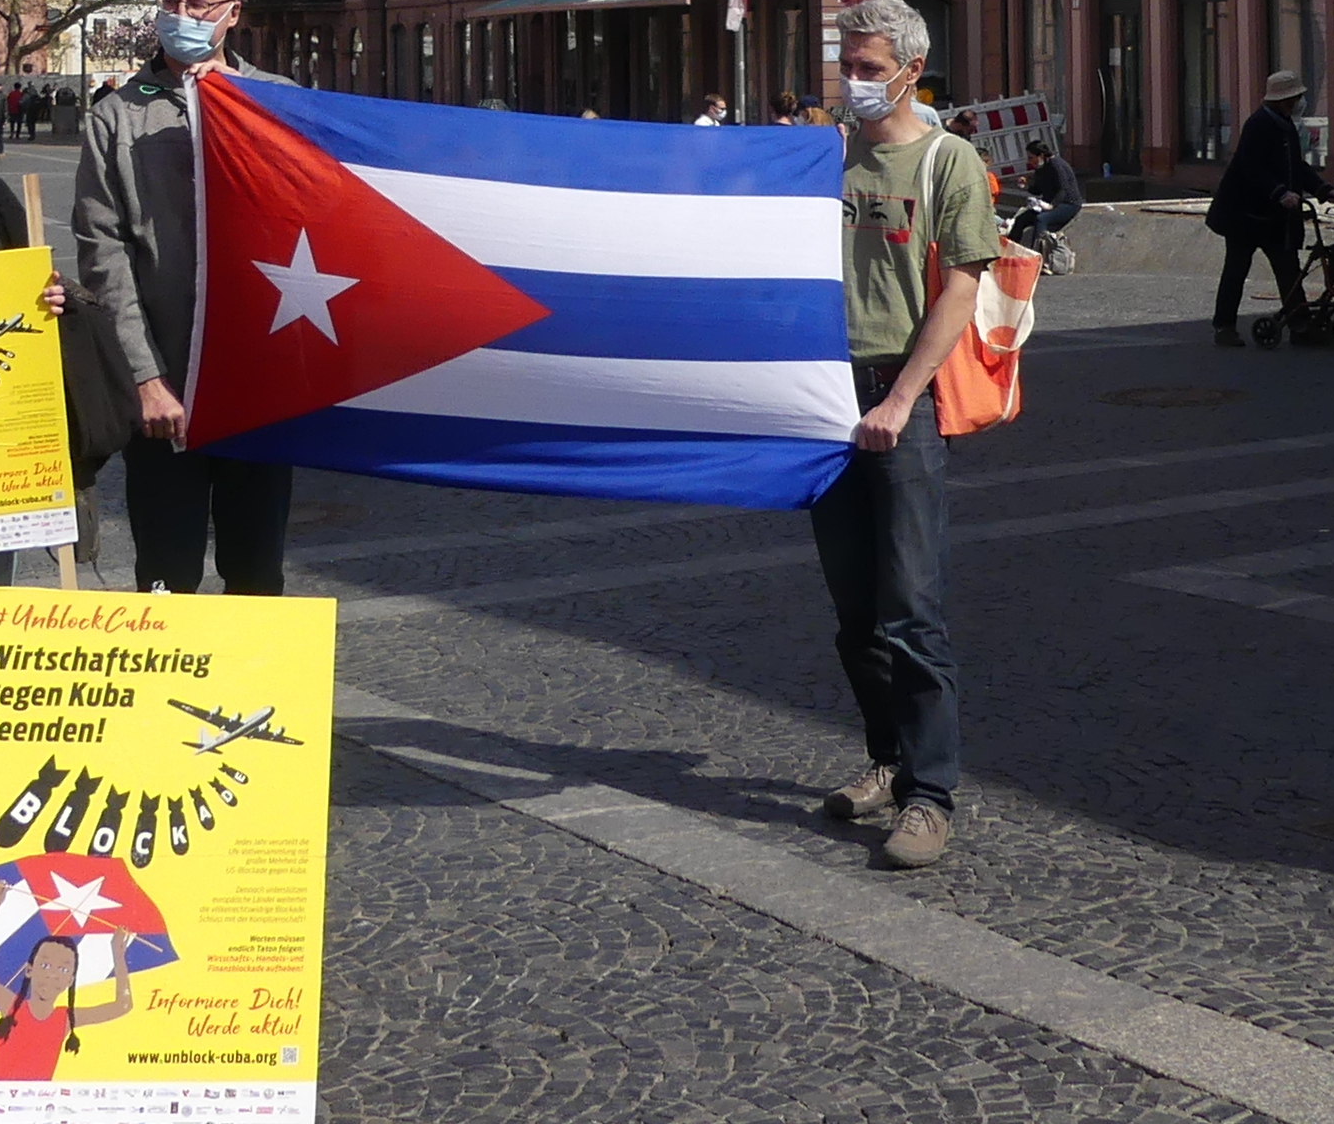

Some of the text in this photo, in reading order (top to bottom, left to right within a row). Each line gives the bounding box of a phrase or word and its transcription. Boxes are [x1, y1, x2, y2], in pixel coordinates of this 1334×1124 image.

[68, 682, 135, 707] Kuba
[146, 987, 304, 1015] Informiere Dich!
[187, 1012, 303, 1037] Werde aktiv!
[128, 1050, 278, 1066] www.unblock-cuba.org
